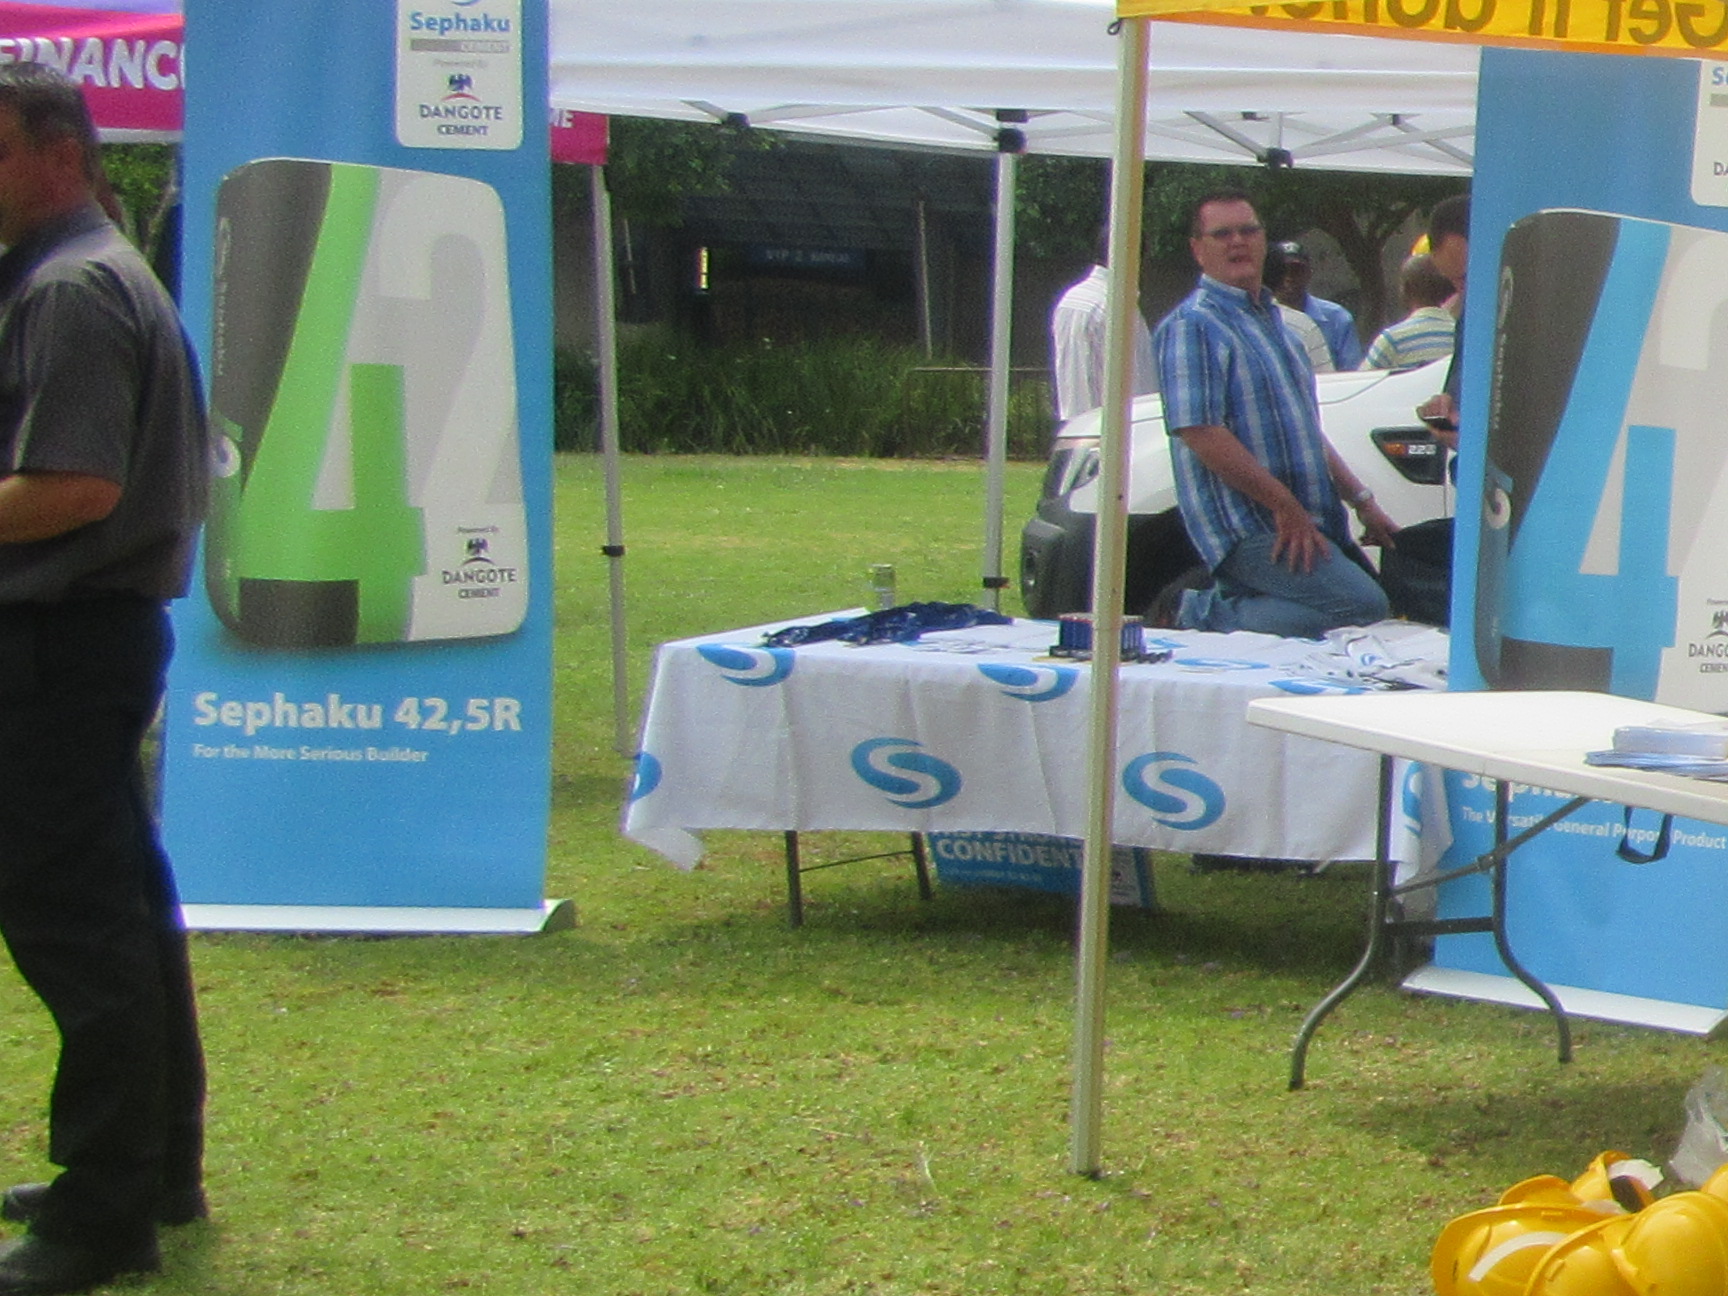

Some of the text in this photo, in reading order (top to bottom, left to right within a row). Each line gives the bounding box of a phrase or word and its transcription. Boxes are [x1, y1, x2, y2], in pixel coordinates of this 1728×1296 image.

[410, 11, 511, 36] Sephaku
[0, 37, 185, 91] FINANC
[419, 104, 504, 120] DANGOTE
[437, 125, 489, 136] CEMENT
[442, 568, 517, 585] DANGOTE
[458, 588, 500, 600] CEMENT
[194, 691, 524, 736] Sephaku 42,5R
[193, 743, 429, 763] For the More Serious Builder
[1462, 806, 1483, 823] The
[1553, 820, 1609, 837] General
[1673, 830, 1728, 850] Product
